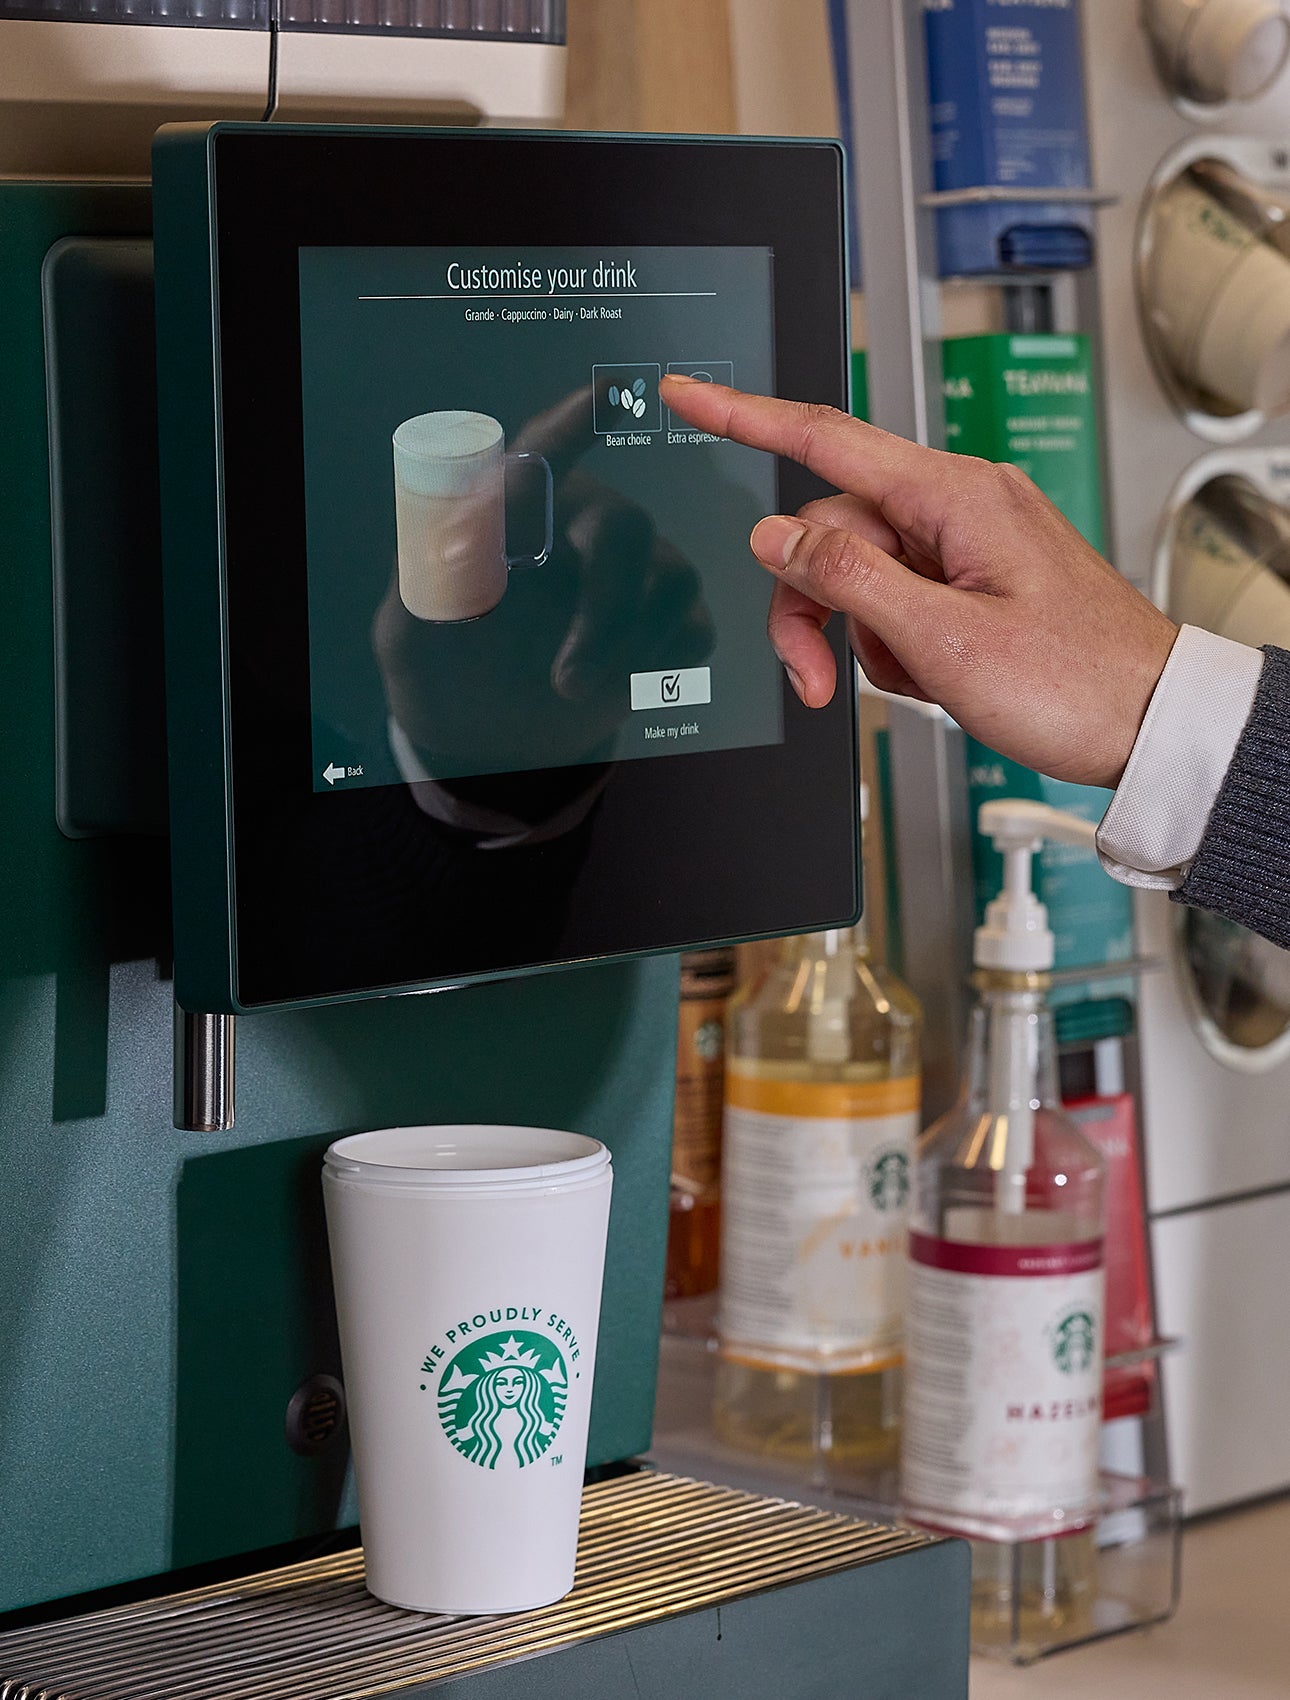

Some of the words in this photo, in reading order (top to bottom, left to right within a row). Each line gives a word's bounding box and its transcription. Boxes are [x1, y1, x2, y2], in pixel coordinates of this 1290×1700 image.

[446, 262, 542, 290] Customise
[547, 268, 588, 294] your
[592, 260, 638, 289] drink
[465, 308, 495, 321] Grande
[501, 308, 547, 323] Cappuccino
[553, 307, 574, 323] Dairy
[580, 307, 599, 320] Dark
[600, 307, 622, 320] Roast
[606, 434, 626, 447] Bean
[627, 433, 652, 446] choice
[667, 432, 687, 444] Extra
[644, 726, 666, 739] Make
[667, 727, 679, 739] my
[680, 722, 700, 736] drink
[347, 765, 364, 777] Back
[420, 1345, 445, 1375] WE
[445, 1306, 542, 1344] PROUDLY
[547, 1313, 581, 1362] SERVE
